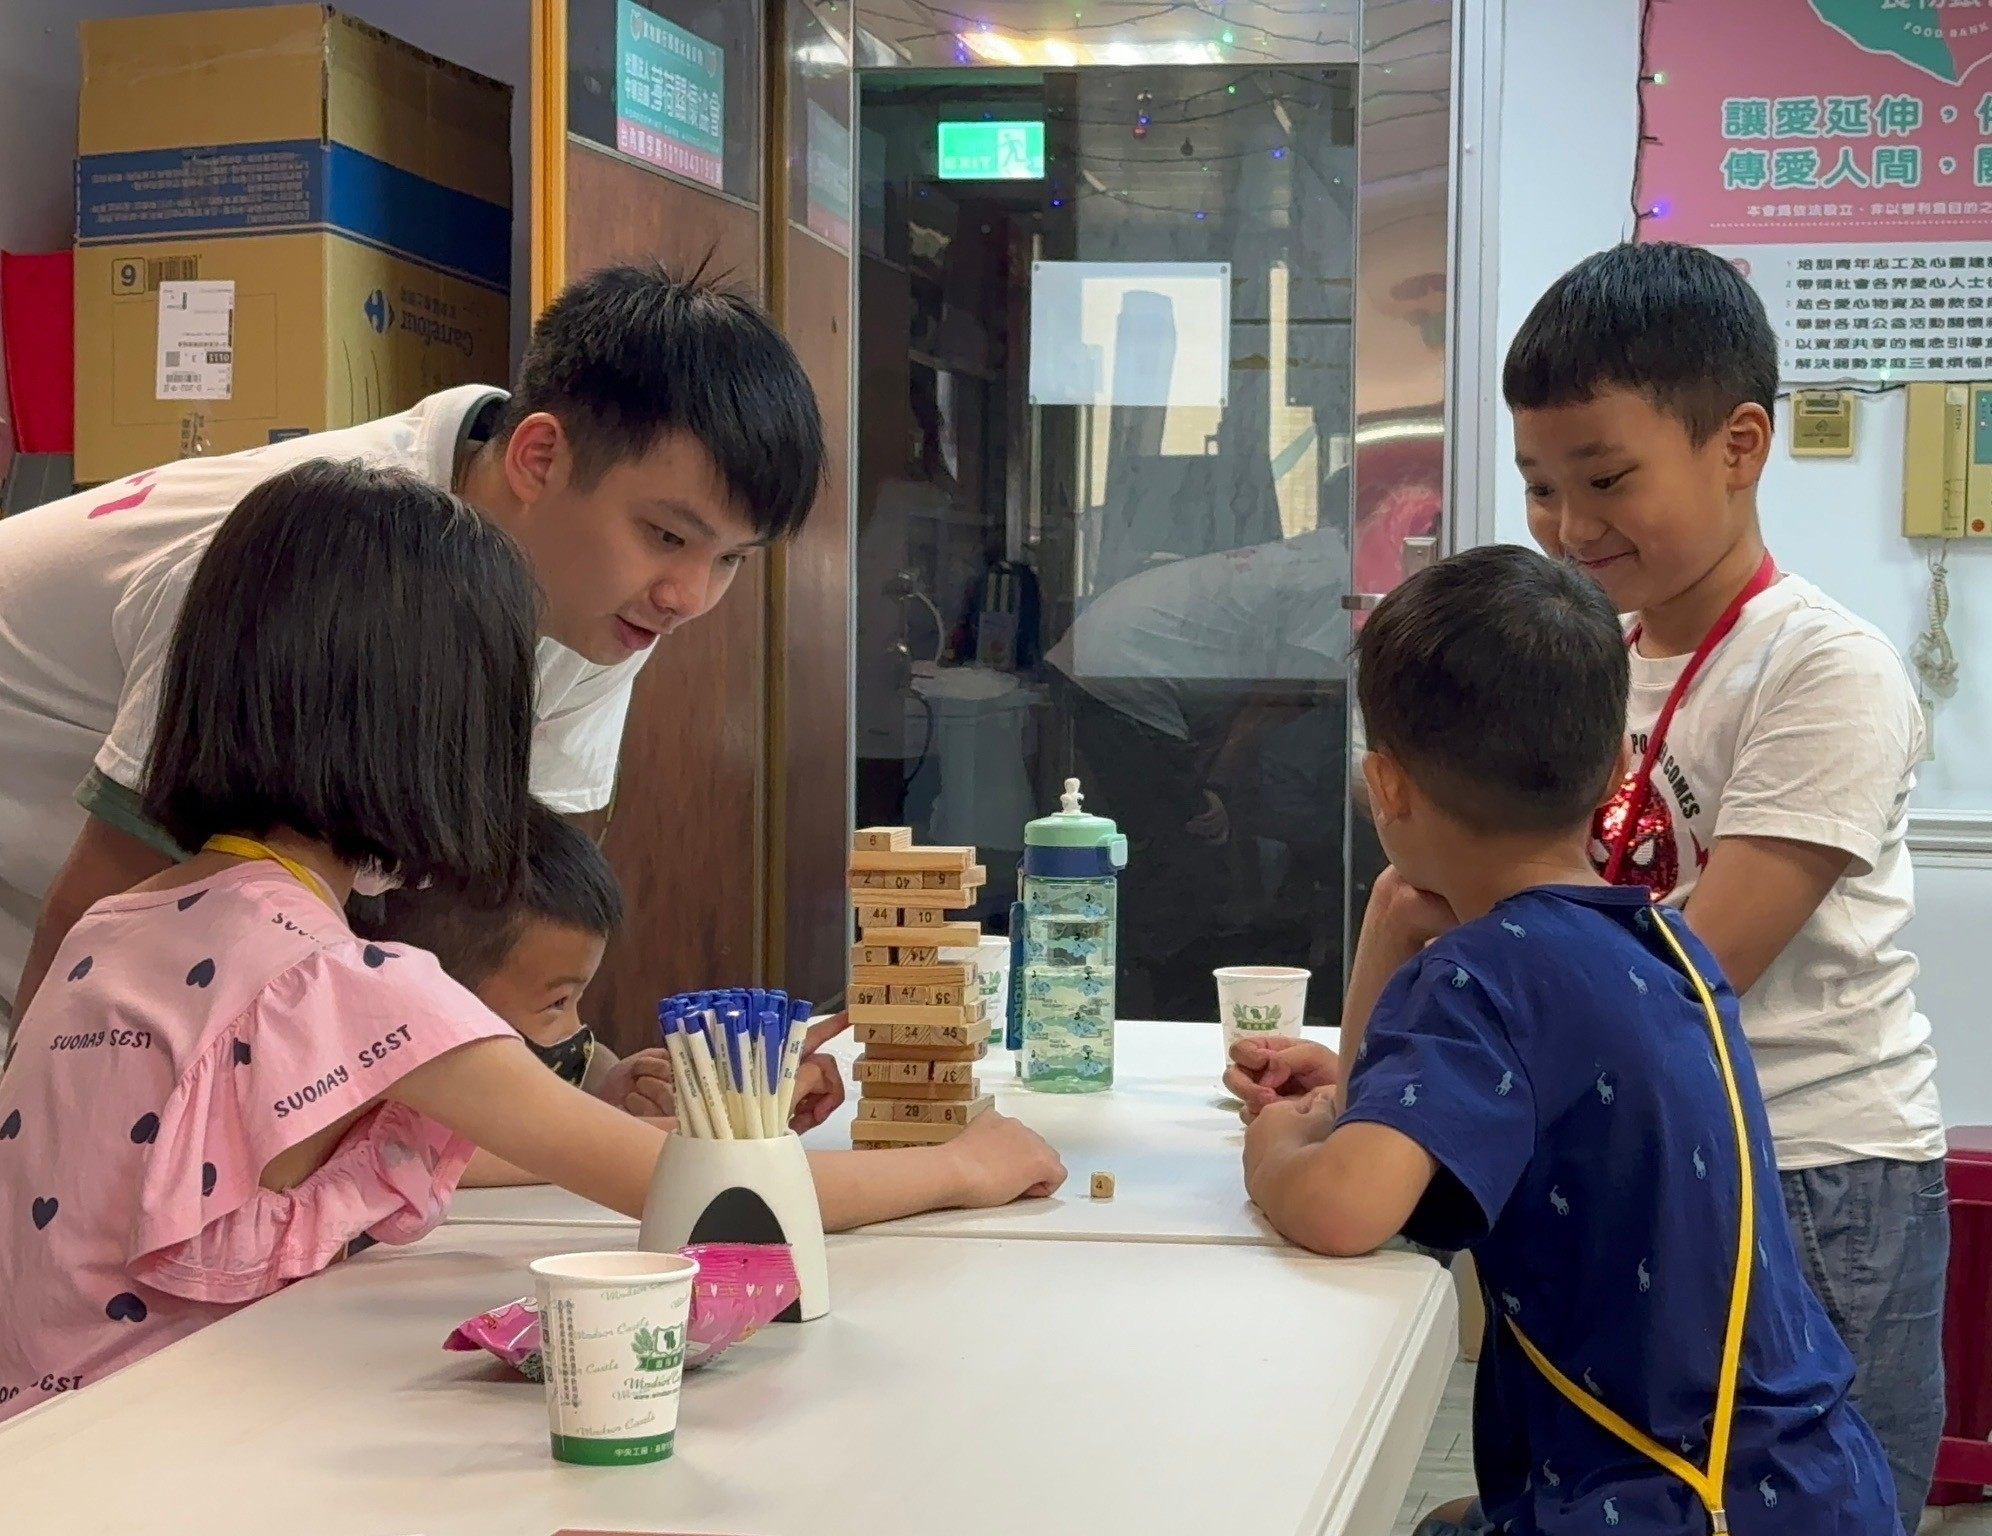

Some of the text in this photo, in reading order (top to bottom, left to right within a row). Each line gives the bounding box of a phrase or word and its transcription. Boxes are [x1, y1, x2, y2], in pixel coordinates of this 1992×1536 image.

[1903, 21, 1989, 38] FOOD BANK
[1722, 94, 1992, 138] 讓愛延伸，
[1797, 257, 1992, 270] 培訓青年志工及心靈建
[1796, 277, 1992, 290] 帶領社會各界愛心人士
[1796, 317, 1992, 330] 舉辦各項公益活動關懷
[1795, 337, 1992, 350] 以資源共享的概念引導
[1795, 357, 1992, 370] 解決弱勢家庭三餐煩惱
[1662, 755, 1701, 819] COMES
[31, 1373, 83, 1393] EST
